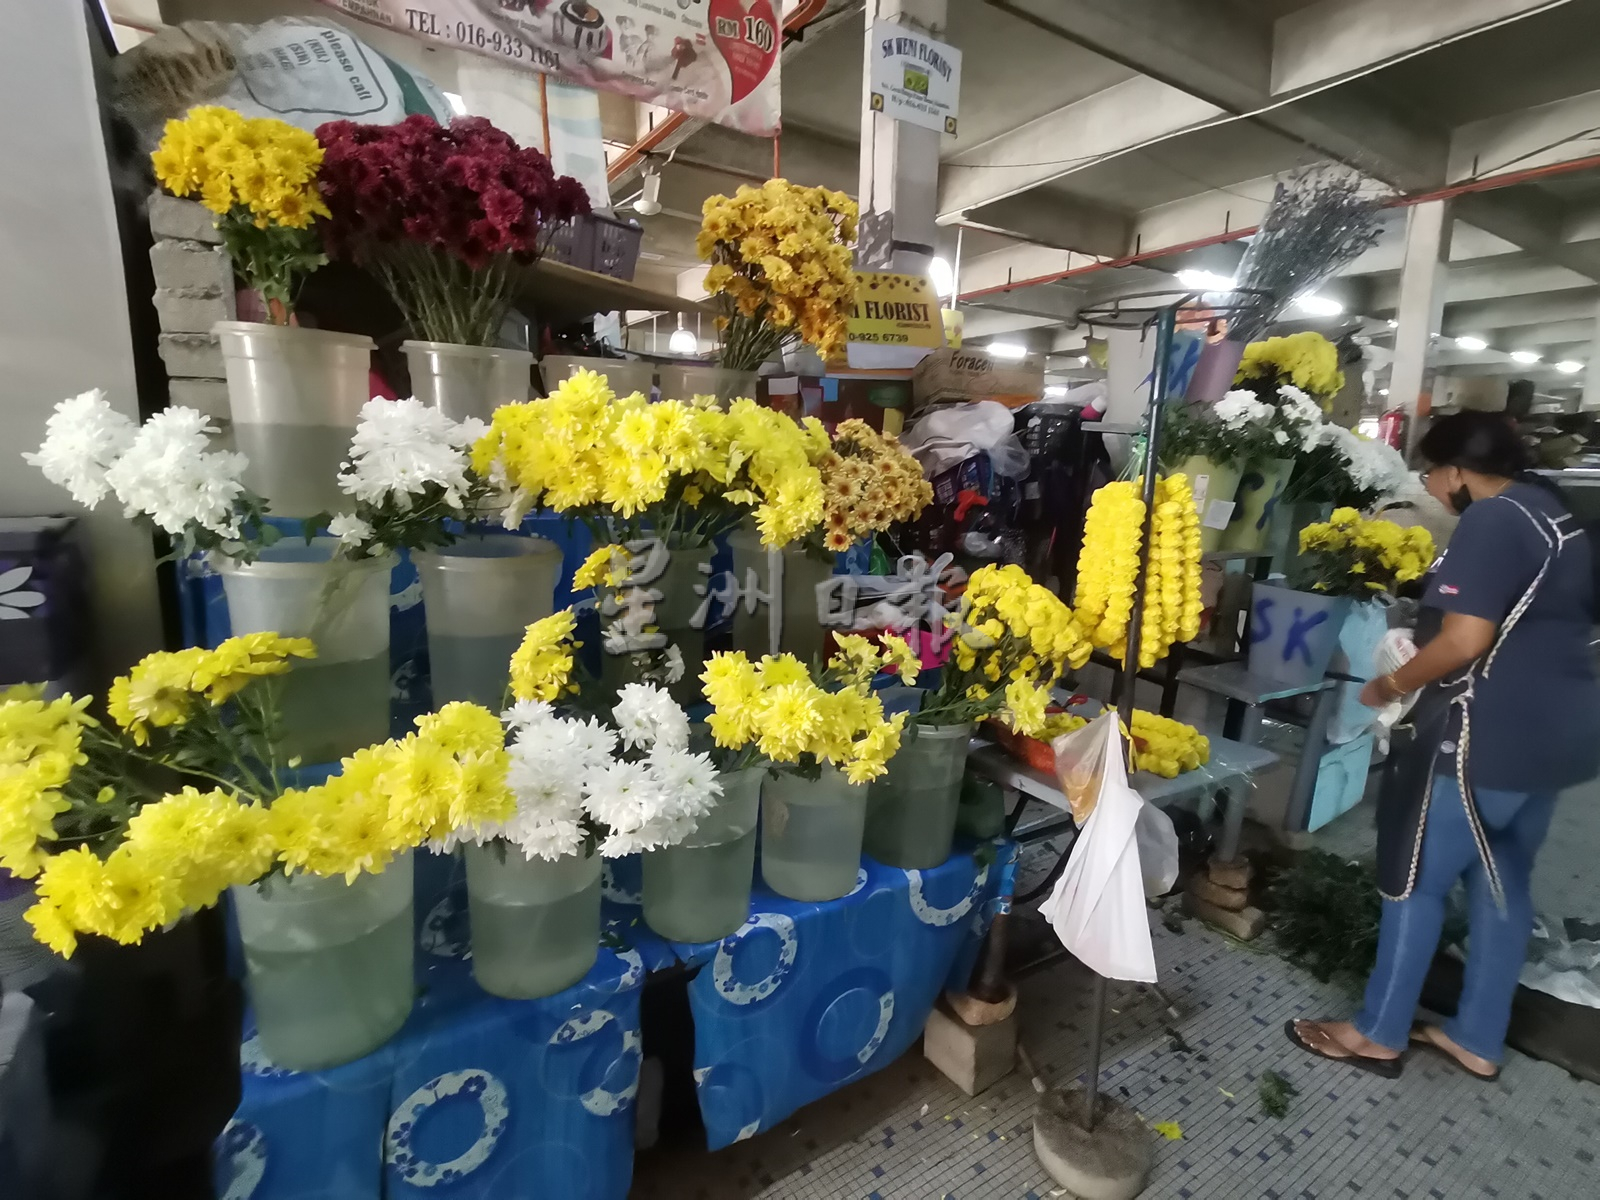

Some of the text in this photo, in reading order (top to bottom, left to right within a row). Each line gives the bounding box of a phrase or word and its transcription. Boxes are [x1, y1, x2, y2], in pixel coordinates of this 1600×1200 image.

[405, 9, 441, 36] TEL
[456, 21, 523, 58] 016-933
[716, 17, 739, 38] RM
[743, 16, 774, 52] 160
[320, 30, 372, 100] please call
[918, 42, 952, 82] FLORIST
[864, 300, 930, 322] FLORIST
[848, 332, 909, 343] 0-925 6739
[1250, 597, 1329, 668] SK
